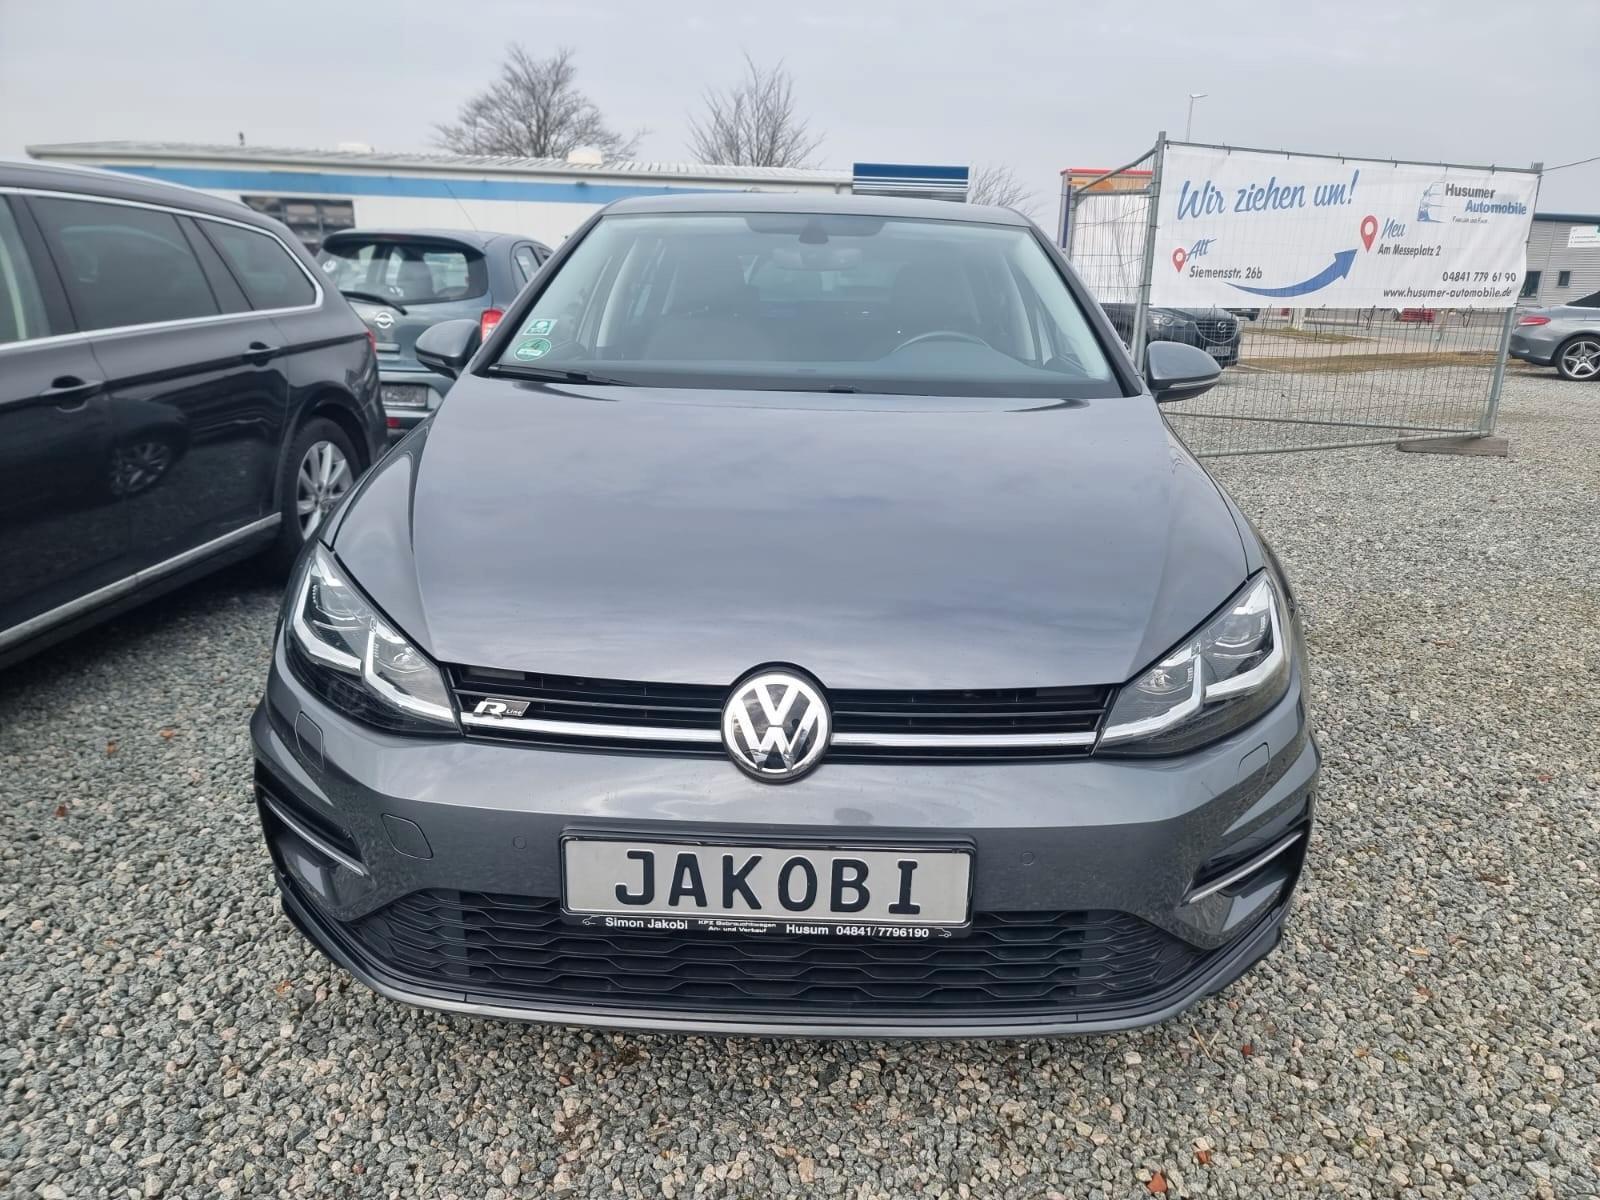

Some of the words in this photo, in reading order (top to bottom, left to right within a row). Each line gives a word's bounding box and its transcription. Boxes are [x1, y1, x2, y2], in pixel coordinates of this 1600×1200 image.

[1177, 180, 1226, 220] Wir
[1234, 176, 1306, 213] ziehen
[1314, 169, 1360, 207] um!
[1445, 183, 1496, 199] Husumer
[1465, 200, 1527, 215] Automobile
[1381, 217, 1406, 239] Neu
[1186, 239, 1217, 262] Alt
[1378, 243, 1391, 255] Am
[1392, 244, 1434, 259] Messeplatz
[1435, 245, 1441, 256] 2
[1189, 265, 1242, 279] Siemensstr.
[1245, 267, 1263, 279] 26b
[1442, 271, 1470, 282] 04841
[1473, 272, 1489, 282] 779
[1492, 272, 1502, 282] 61
[1505, 272, 1516, 282] 90
[1383, 286, 1512, 298] www.husumer-automobile.de
[473, 700, 507, 719] R
[615, 849, 921, 915] JAKOBI
[605, 917, 644, 928] Simon
[648, 918, 688, 930] Jakobi
[786, 923, 829, 935] Husum
[836, 925, 929, 938] 04841/7796190
